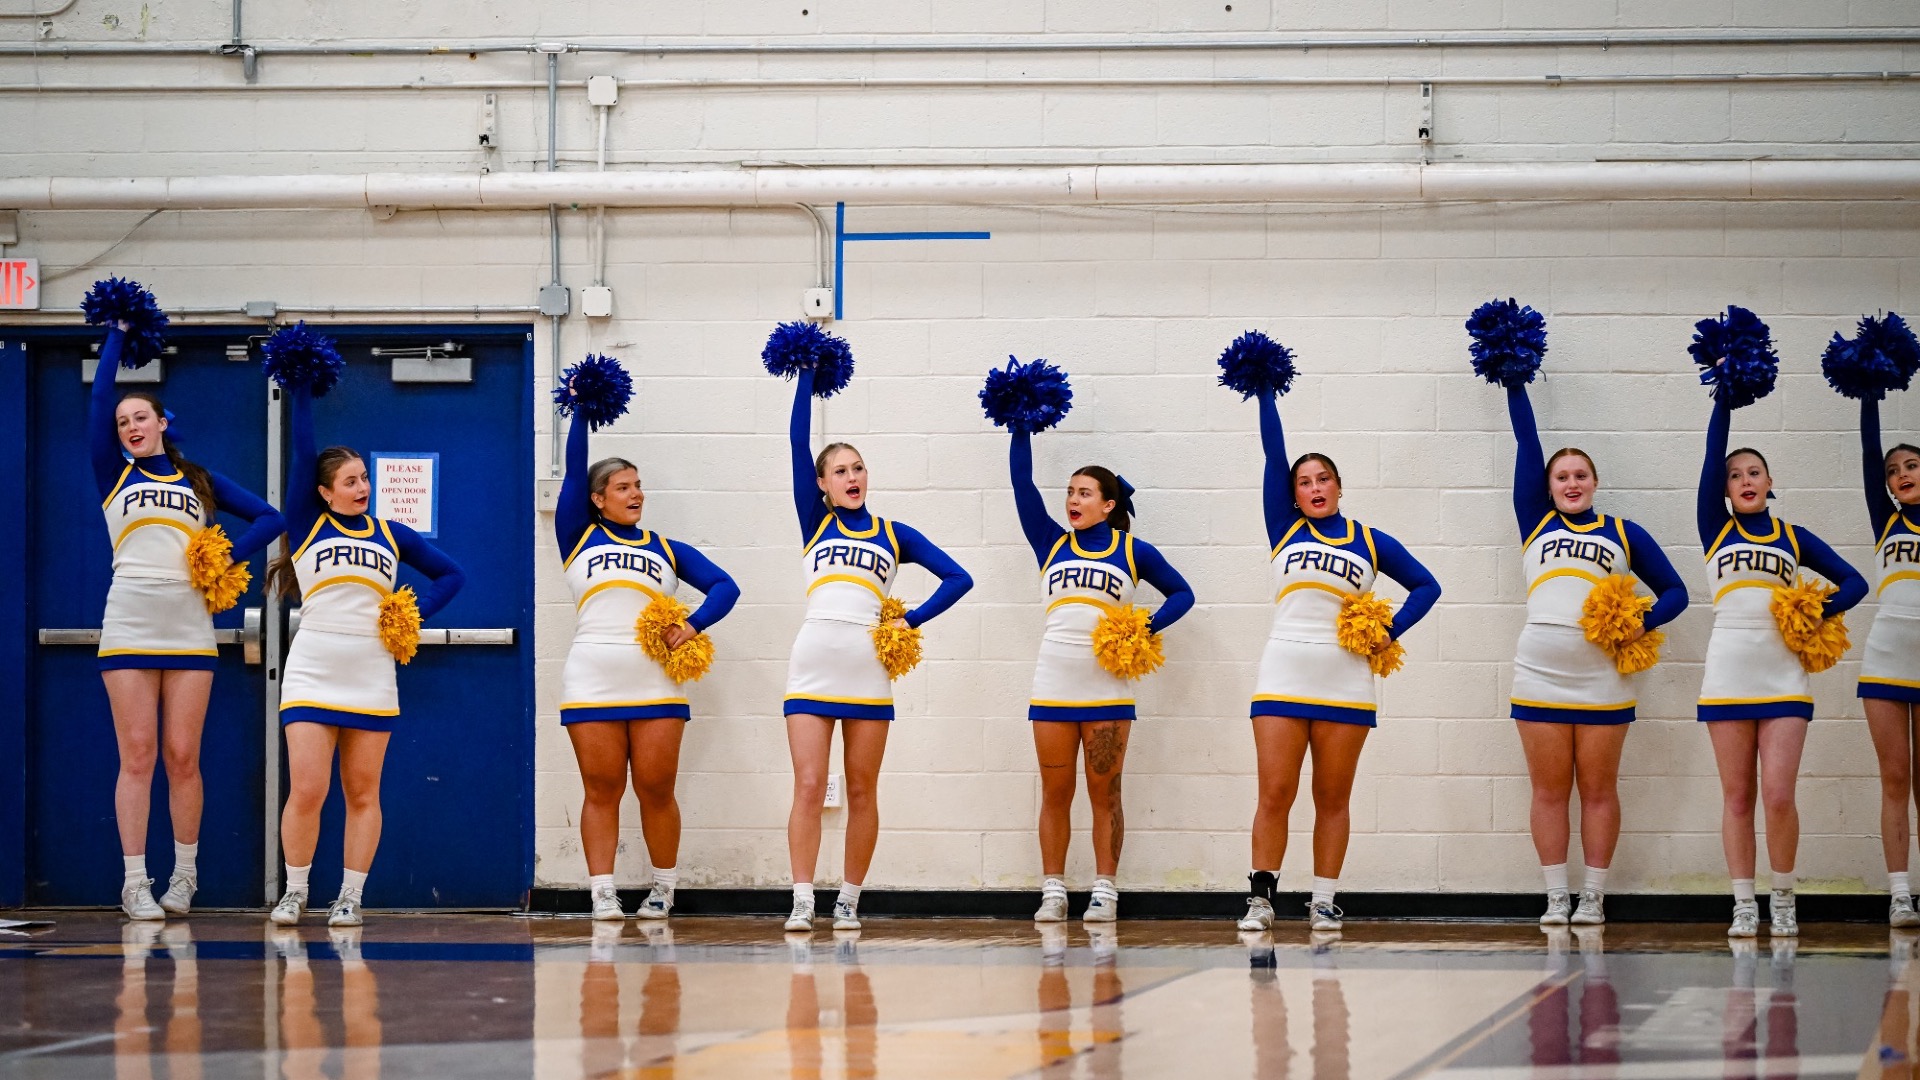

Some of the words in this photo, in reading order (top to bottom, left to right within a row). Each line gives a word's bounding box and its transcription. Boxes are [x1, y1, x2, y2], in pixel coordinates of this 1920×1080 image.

[0, 261, 27, 305] IT
[386, 464, 423, 473] PLEASE
[122, 489, 199, 522] PRIDE
[314, 545, 393, 582] PRIDE
[587, 552, 662, 585] PRIDE
[813, 545, 891, 584] PRIDE
[1284, 550, 1364, 590] PRIDE
[1540, 538, 1615, 575] PRIDE
[1717, 550, 1794, 588] PRIDE
[1048, 567, 1124, 602] PRIDE
